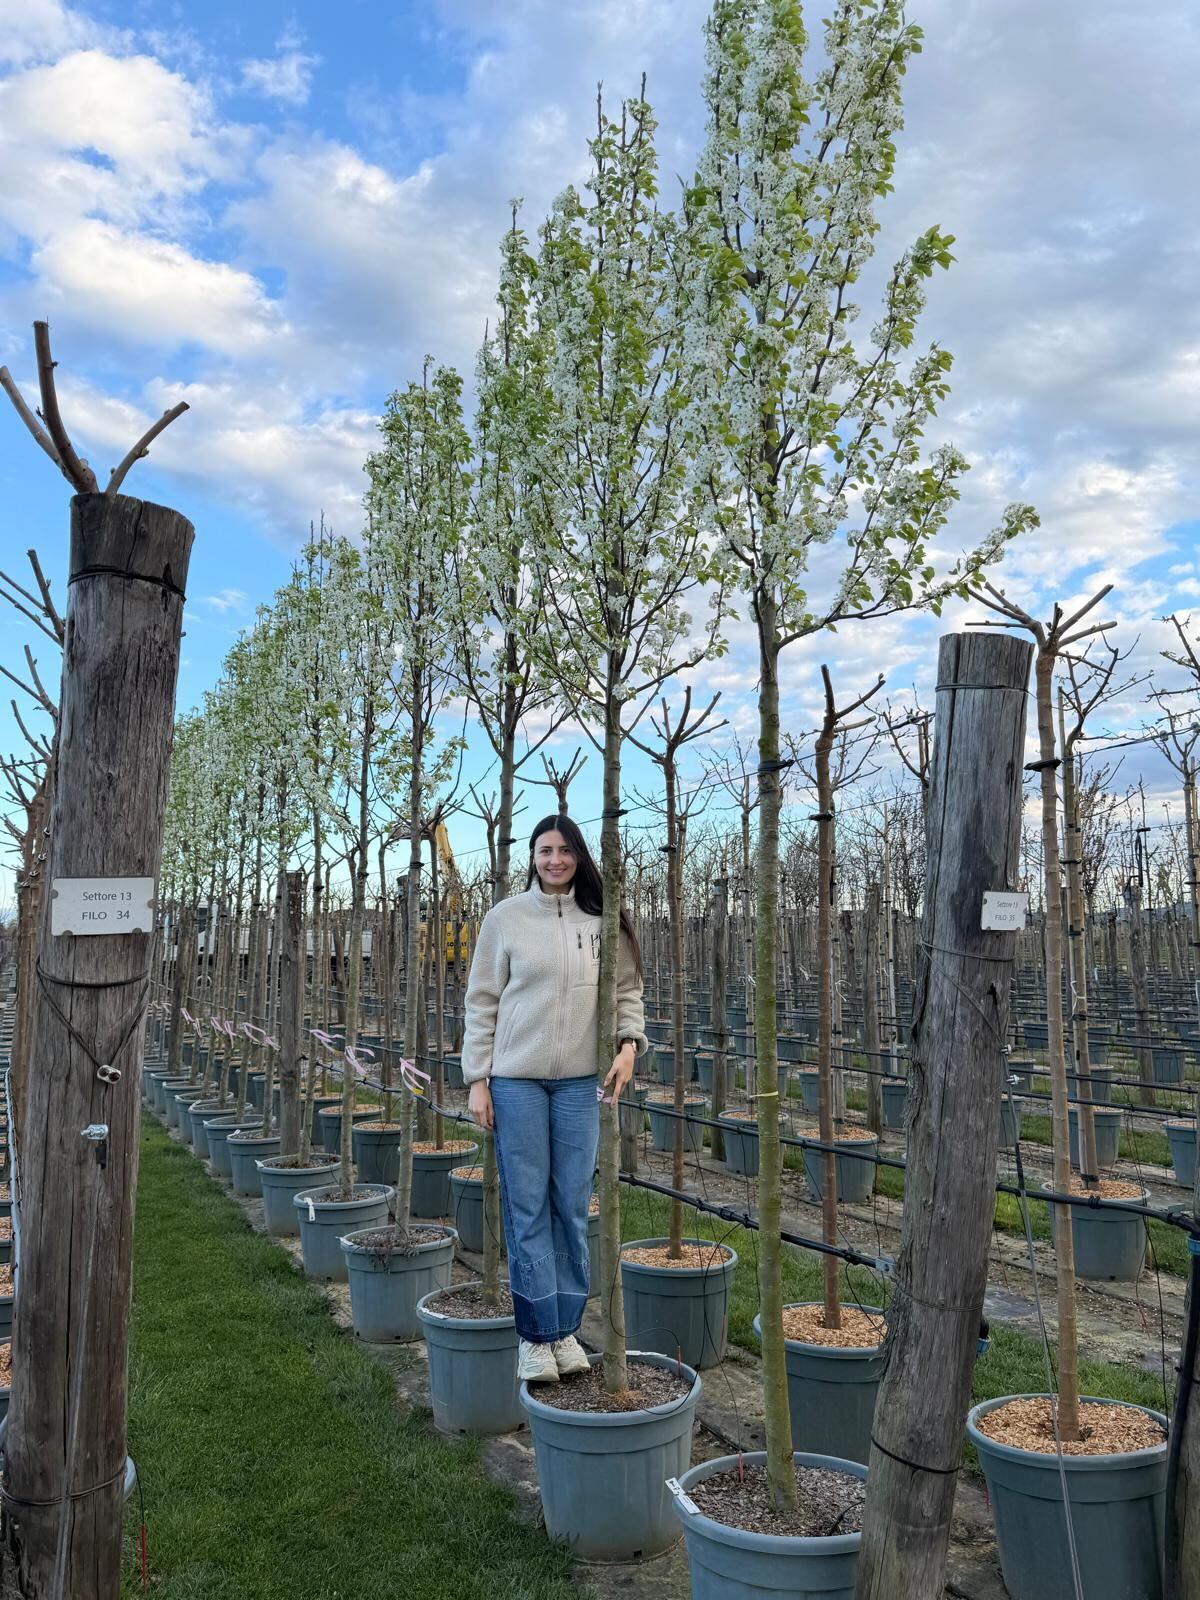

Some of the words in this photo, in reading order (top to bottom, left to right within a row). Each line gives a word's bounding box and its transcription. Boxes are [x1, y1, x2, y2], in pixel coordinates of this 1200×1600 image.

[82, 892, 117, 901] Settore
[120, 892, 132, 901] 13
[82, 912, 107, 920] FILO
[116, 911, 130, 919] 34
